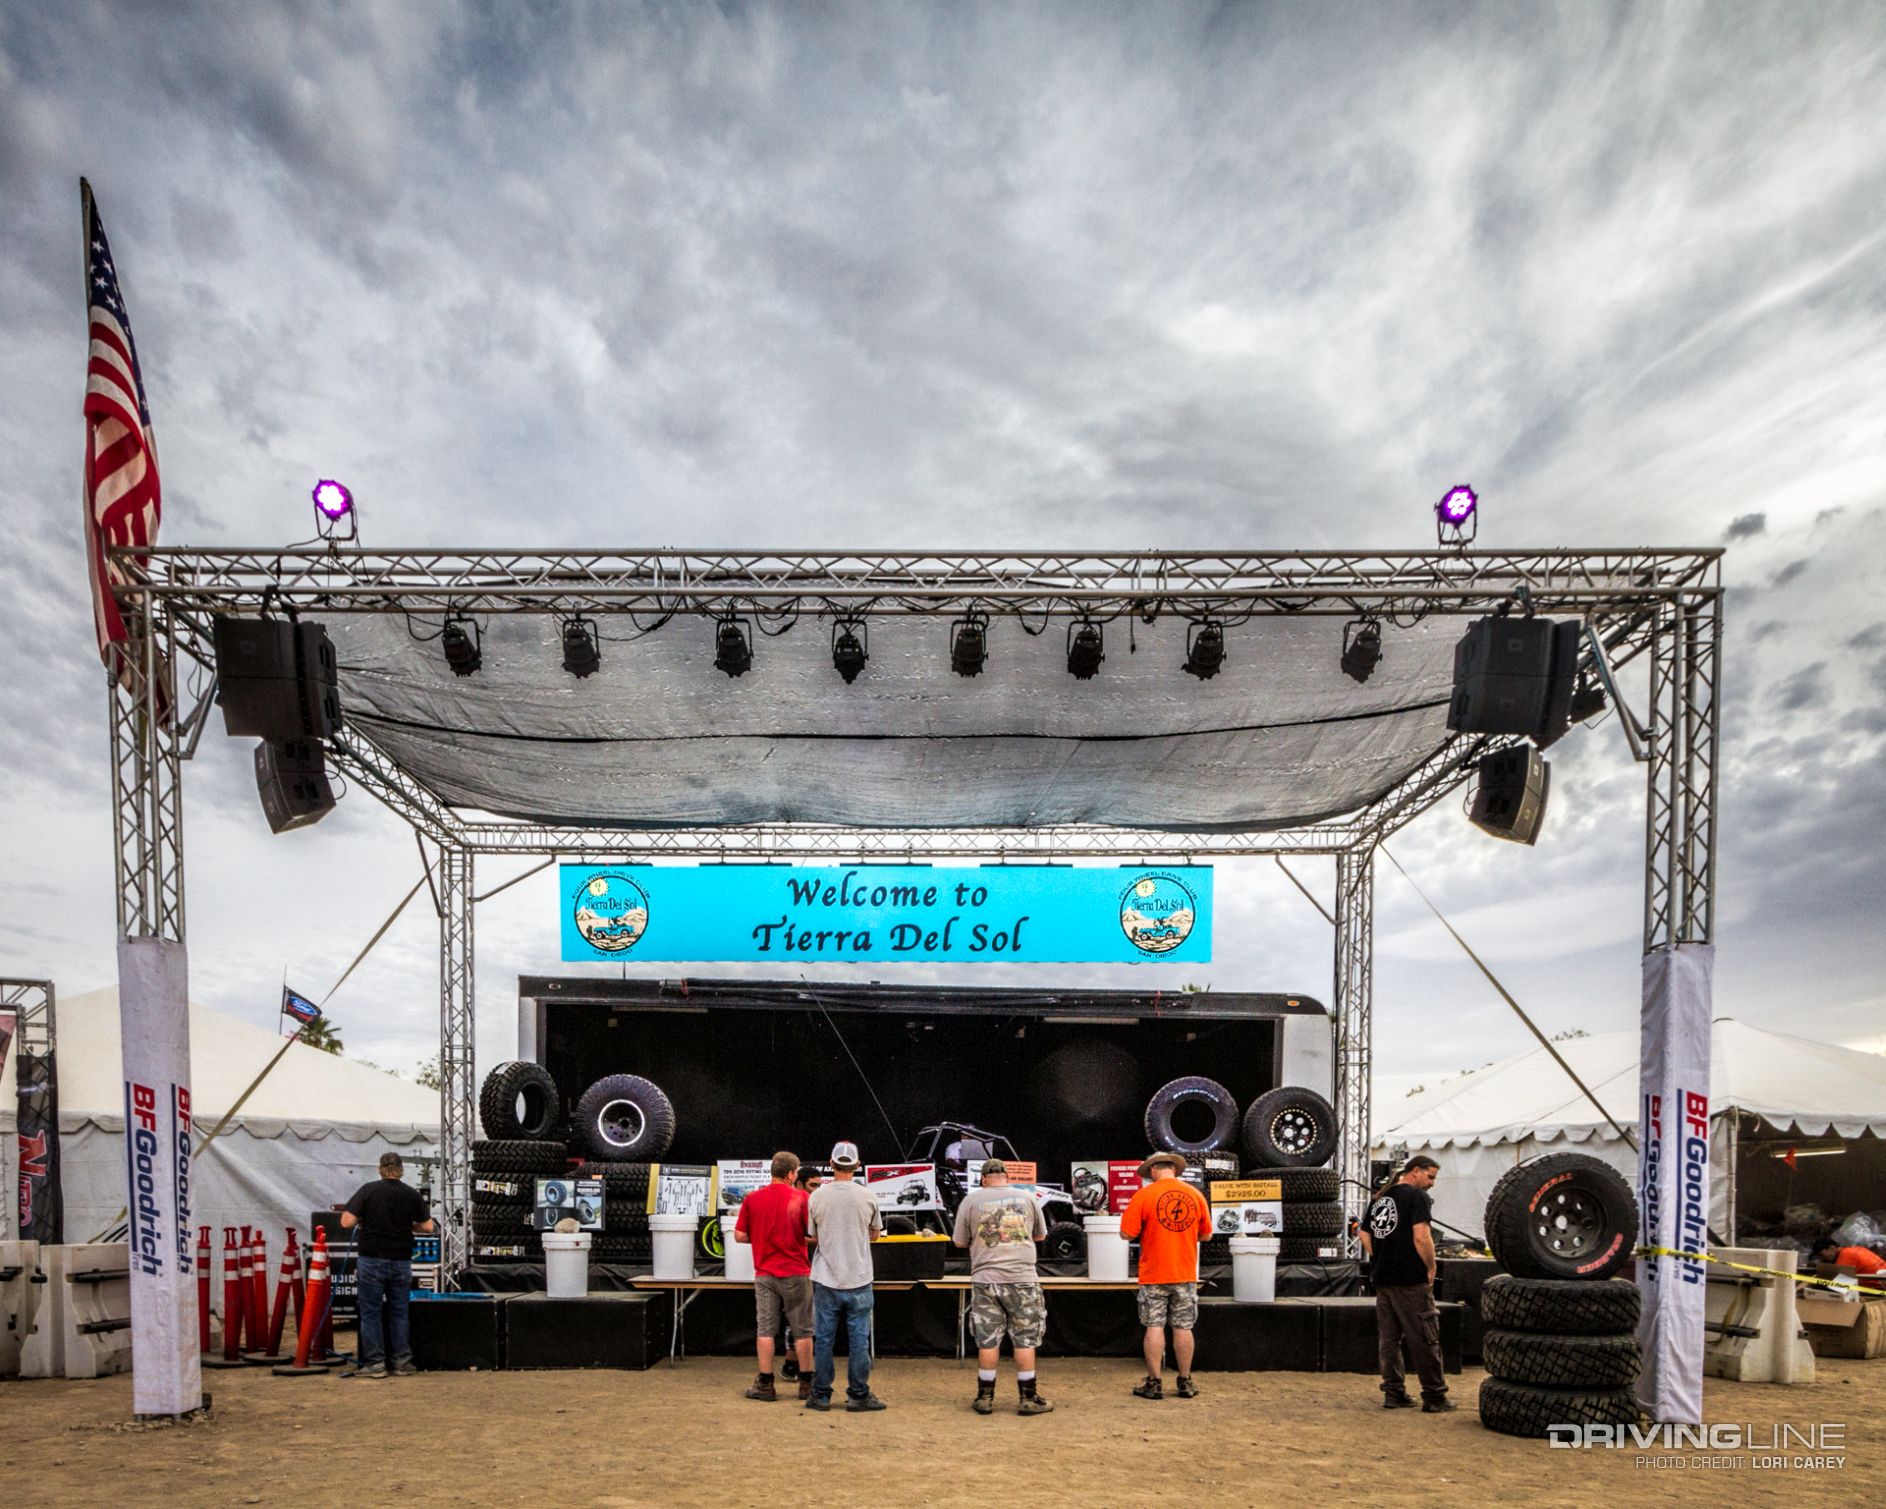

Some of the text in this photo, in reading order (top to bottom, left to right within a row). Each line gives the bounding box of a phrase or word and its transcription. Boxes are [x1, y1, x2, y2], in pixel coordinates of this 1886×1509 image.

[786, 870, 988, 907] Welcome to
[1118, 880, 1135, 900] FOUR
[1183, 881, 1198, 900] CLUB
[585, 897, 637, 912] Tierra Del Sol
[1131, 898, 1184, 912] Tierra Del Sol
[752, 914, 1030, 952] Tierra Del Sol
[592, 948, 633, 957] SAN DIEGO
[1137, 950, 1177, 959] SAN DIEGO
[132, 1083, 163, 1276] BFGoodrich
[177, 1086, 193, 1274] BFGoodrich
[1682, 1090, 1709, 1284] BFGoodrich
[1375, 1207, 1388, 1227] 4
